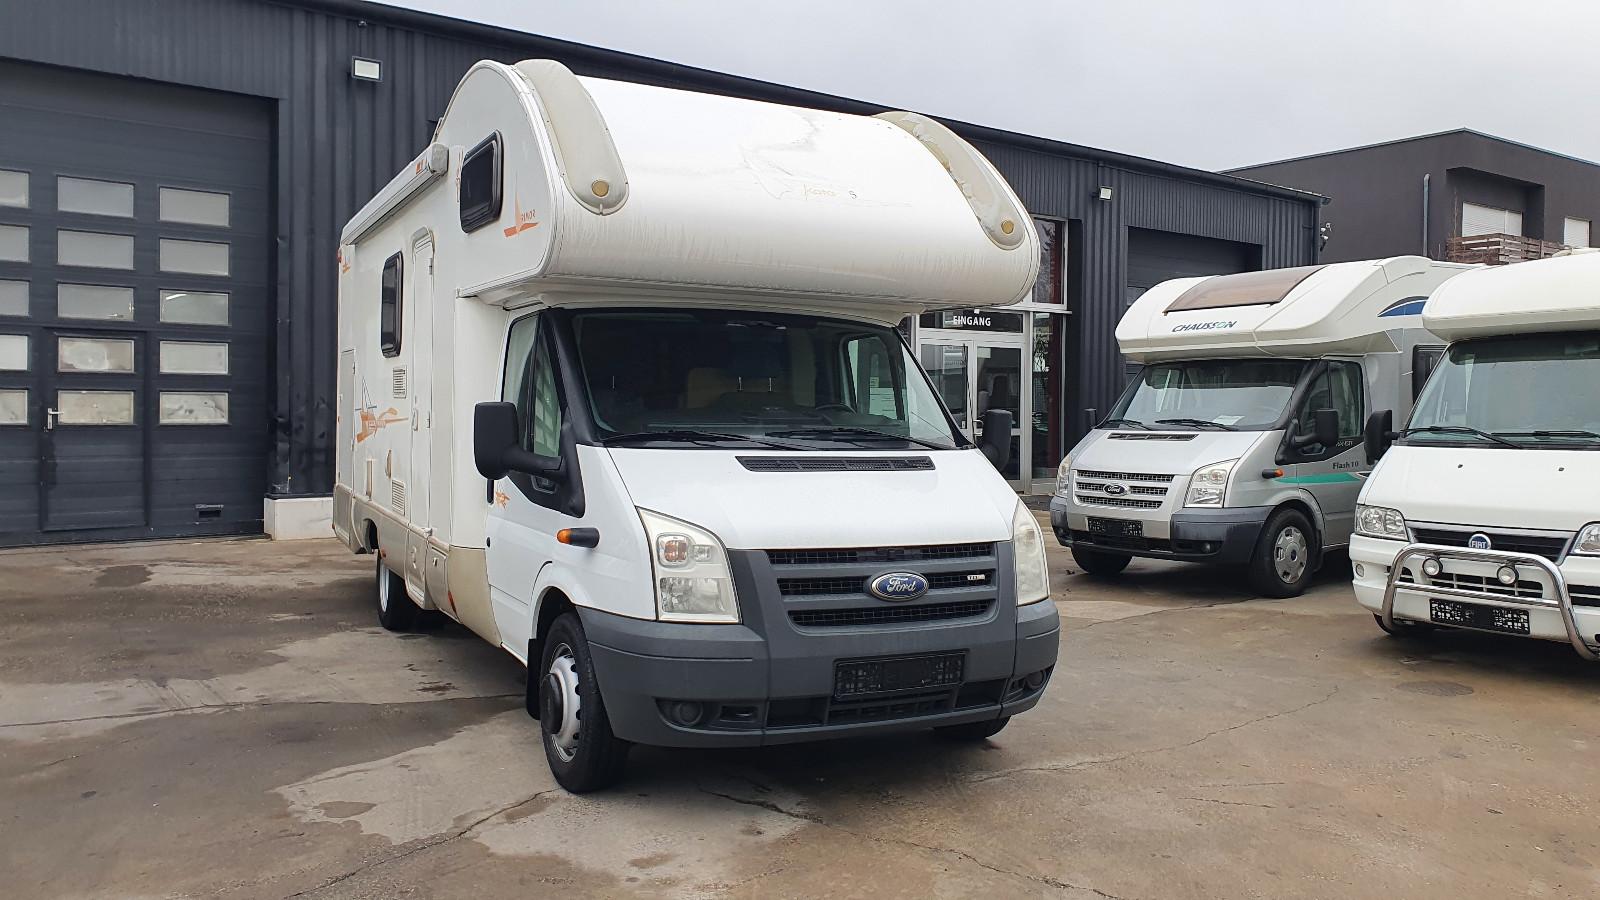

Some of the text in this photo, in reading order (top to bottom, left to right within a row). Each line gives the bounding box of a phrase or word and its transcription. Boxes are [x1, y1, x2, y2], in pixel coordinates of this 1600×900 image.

[953, 315, 991, 327] EINGANG
[1172, 320, 1237, 333] CHAUSSON
[1332, 460, 1359, 470] Flash 10
[1107, 485, 1121, 493] Ford
[1471, 540, 1487, 549] FIAT
[886, 577, 917, 593] Ford
